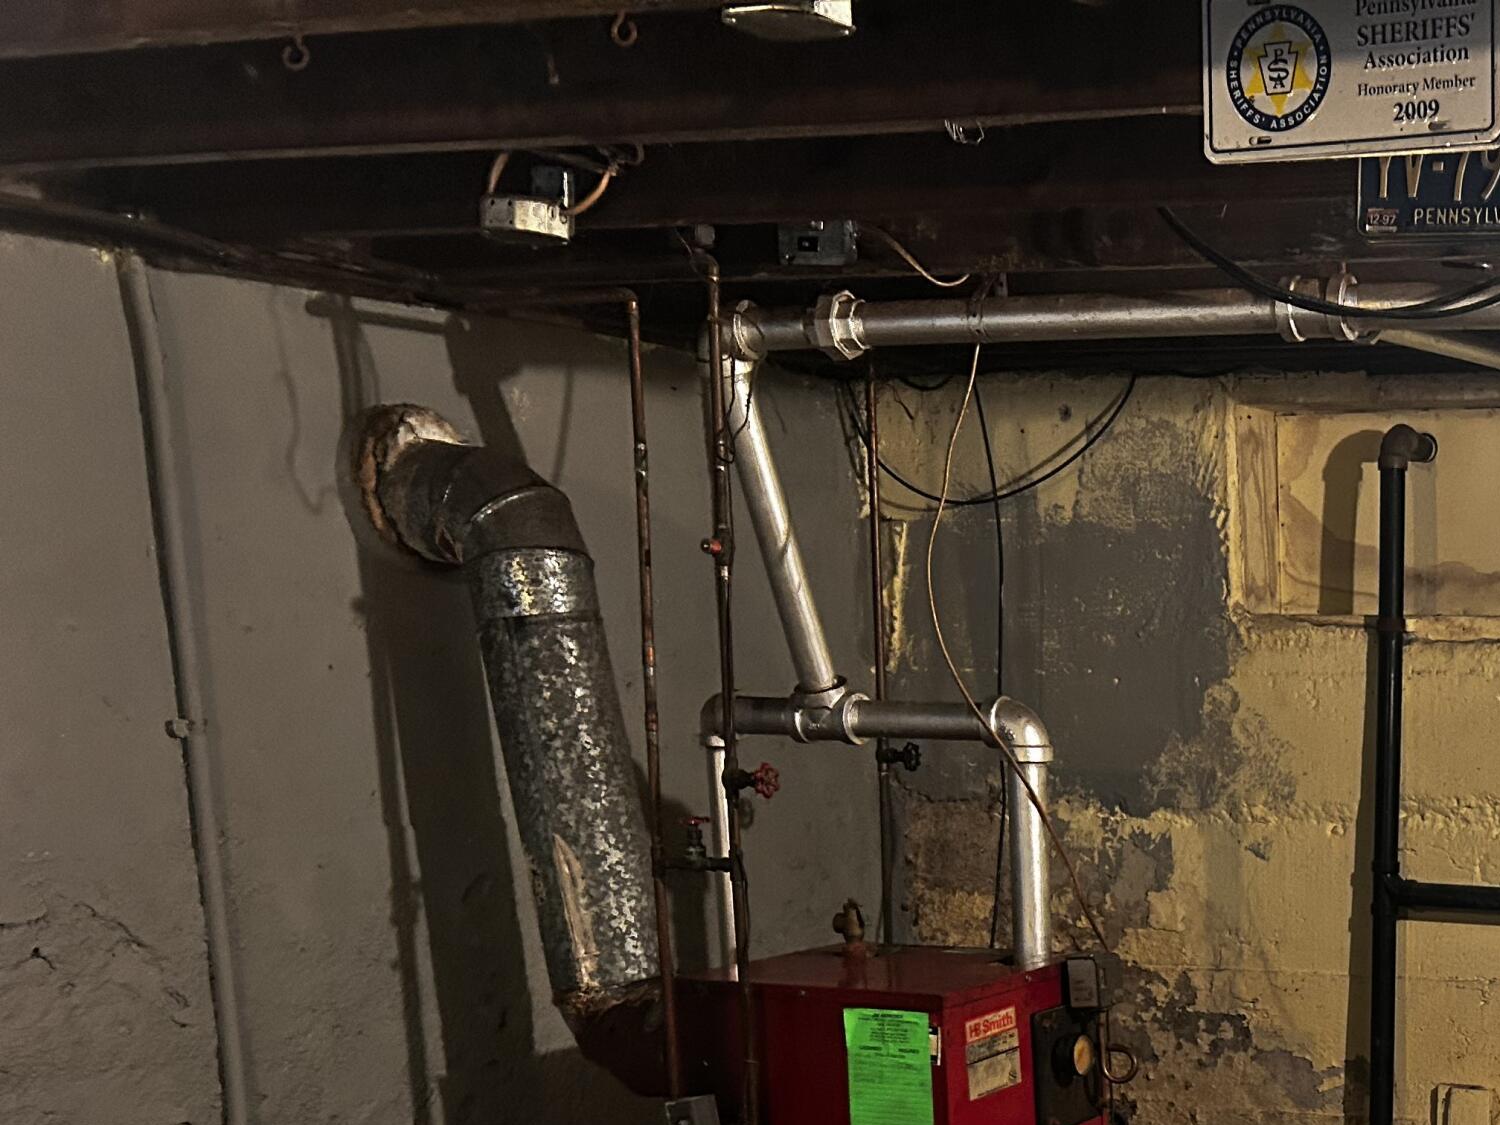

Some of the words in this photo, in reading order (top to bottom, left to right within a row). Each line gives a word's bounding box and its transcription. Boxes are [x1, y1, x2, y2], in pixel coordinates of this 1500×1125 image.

[1355, 0, 1477, 17] Pennsylvan
[1357, 12, 1475, 47] SHERIFFS'
[1364, 43, 1470, 70] Association
[1269, 54, 1328, 130] ASSOCIATION
[1357, 80, 1420, 97] Honorary
[1422, 74, 1476, 91] Member
[1392, 98, 1440, 121] 2009
[982, 1011, 1014, 1034] Smith
